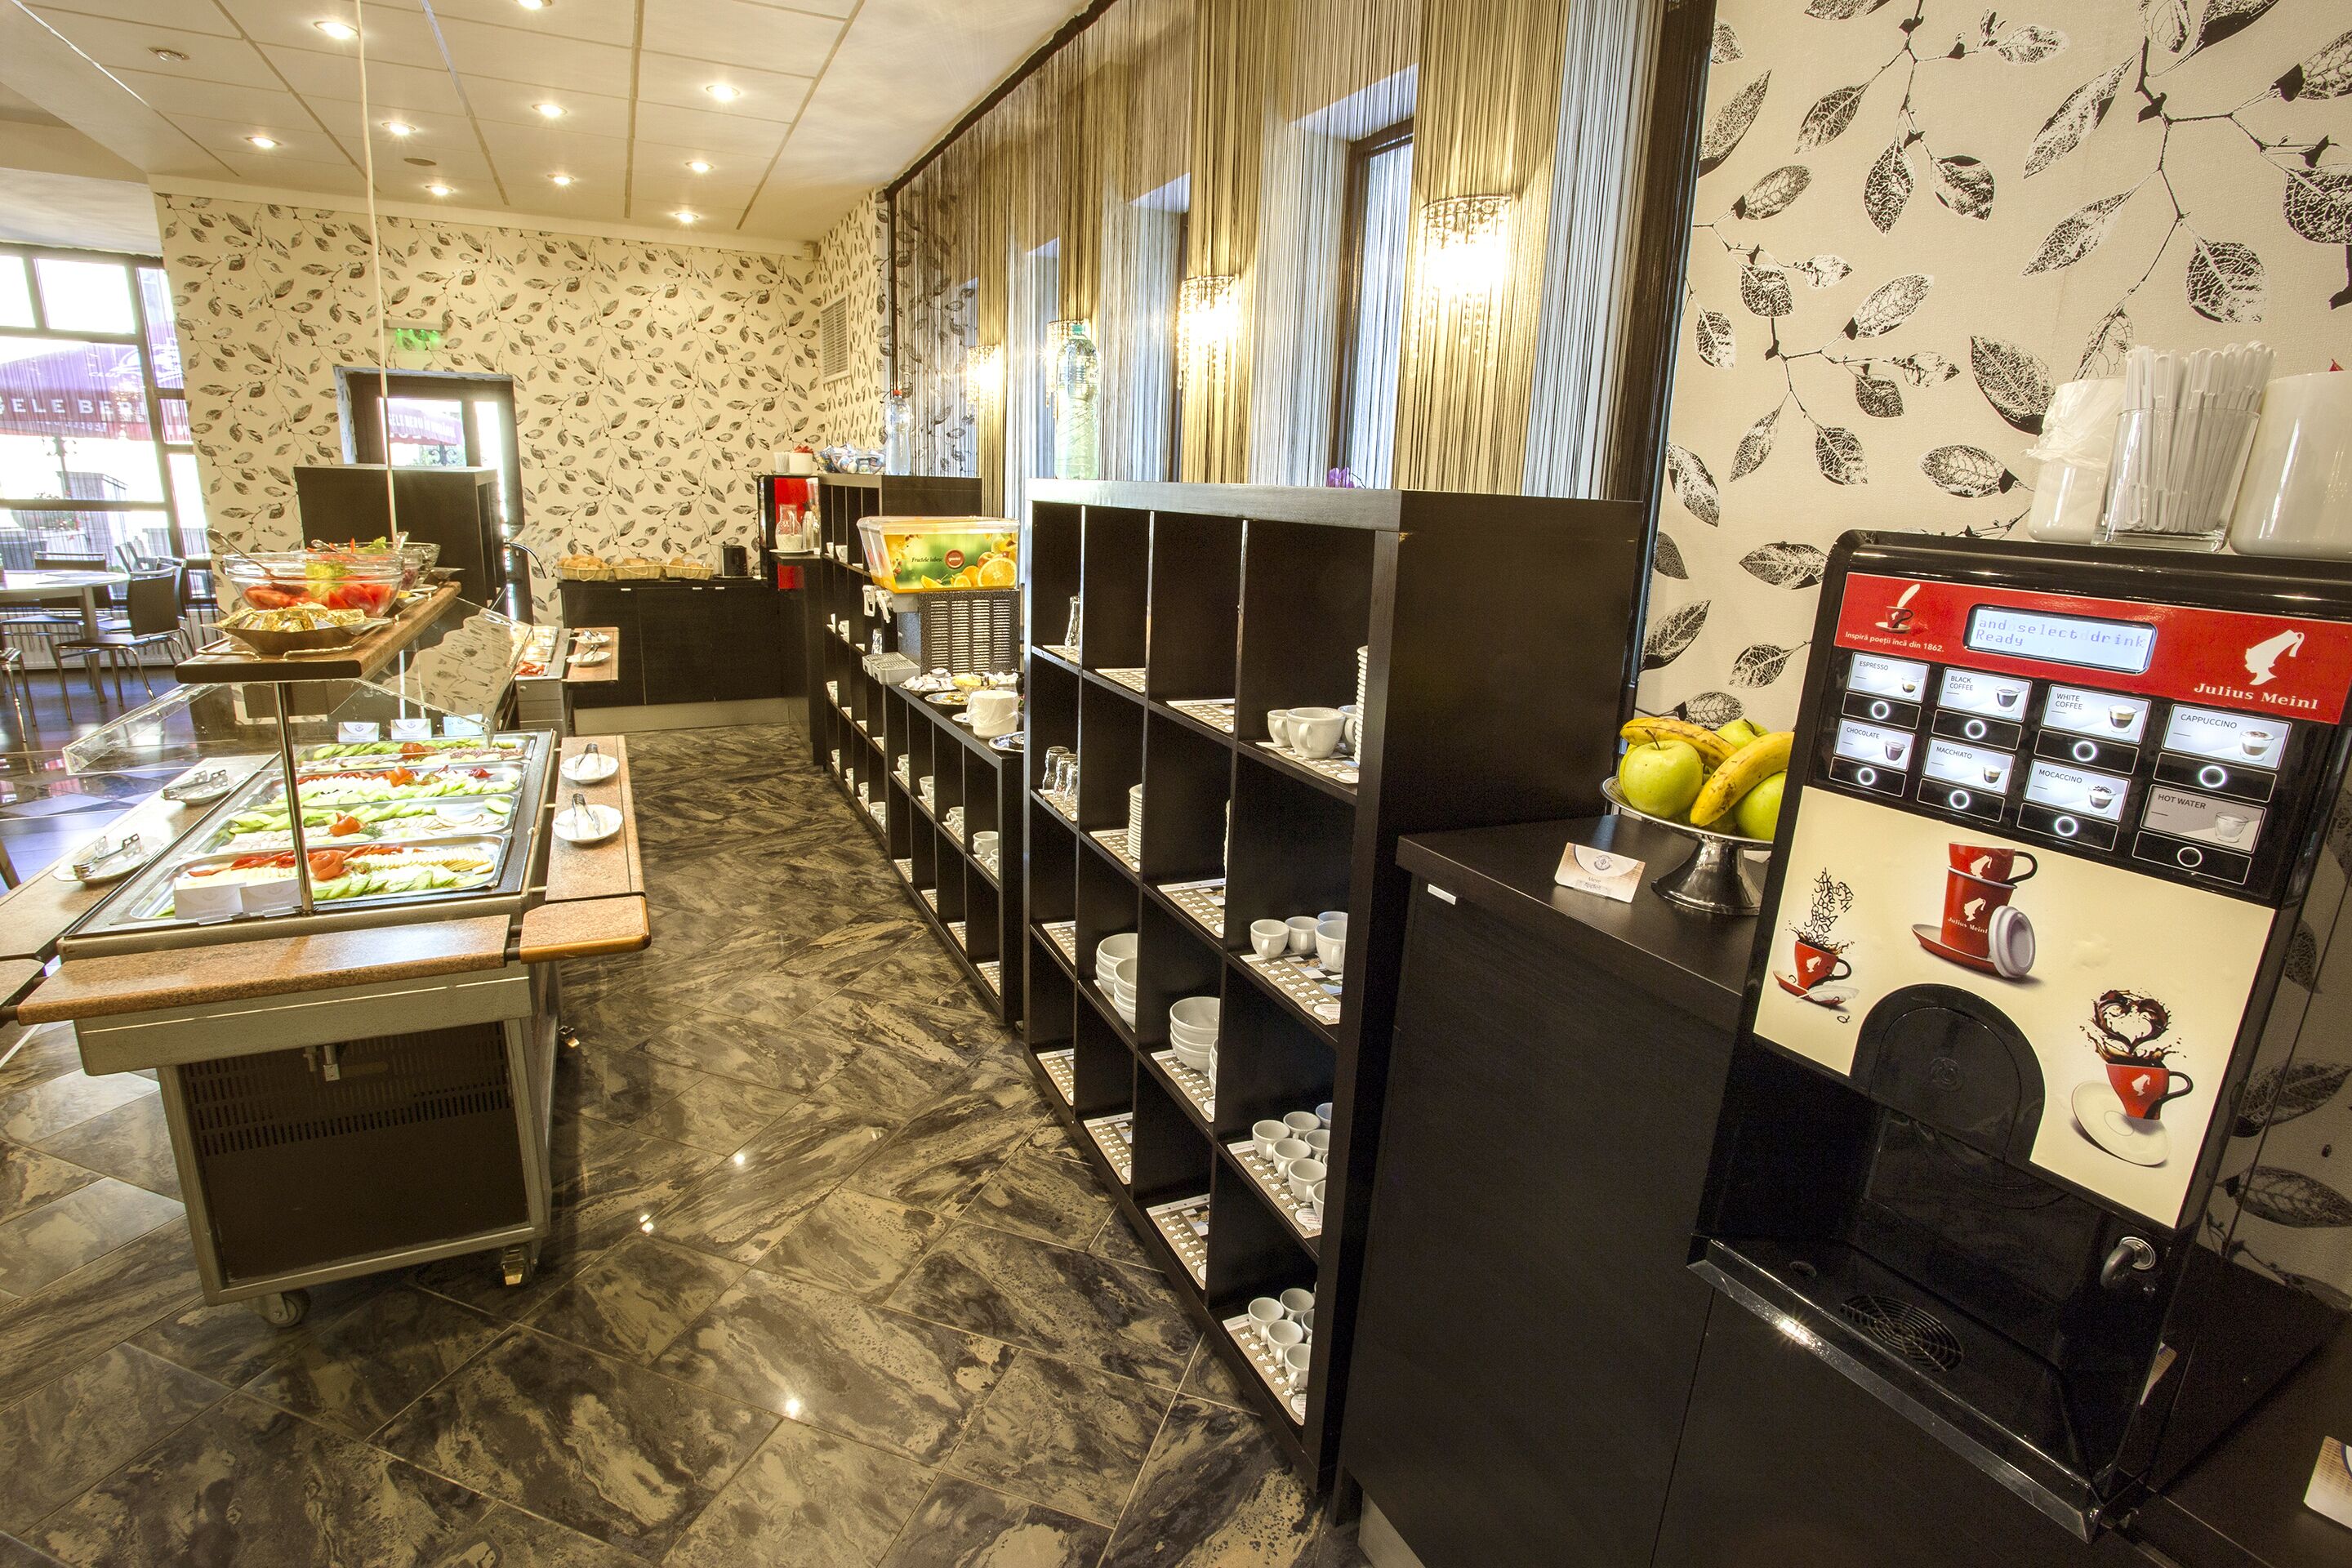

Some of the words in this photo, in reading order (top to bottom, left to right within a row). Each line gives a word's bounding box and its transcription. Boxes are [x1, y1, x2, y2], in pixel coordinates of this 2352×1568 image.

[1976, 629, 2024, 647] Ready
[1979, 617, 2007, 630] and
[2018, 624, 2078, 639] select
[2090, 630, 2145, 648] drink
[1909, 640, 1921, 648] din
[1923, 643, 1944, 653] 1862.
[1859, 660, 1889, 670] ESPRESSO
[1950, 675, 1972, 684] BLACK
[1949, 683, 1974, 692] COFFEE
[2056, 693, 2081, 702] WHITE
[2194, 683, 2254, 701] Julius
[2261, 692, 2319, 710] Meinl
[2055, 701, 2083, 710] COFFEE
[2180, 714, 2238, 729] CAPPUCCINO
[1846, 726, 1881, 740] CHOCOLATE
[1936, 746, 1973, 760] MACCHIATO
[2038, 768, 2083, 784] MOCACCINO
[2158, 794, 2176, 804] HOT
[2177, 797, 2207, 809] WATER
[1947, 916, 1967, 928] Julius
[1969, 924, 1989, 933] Meinl
